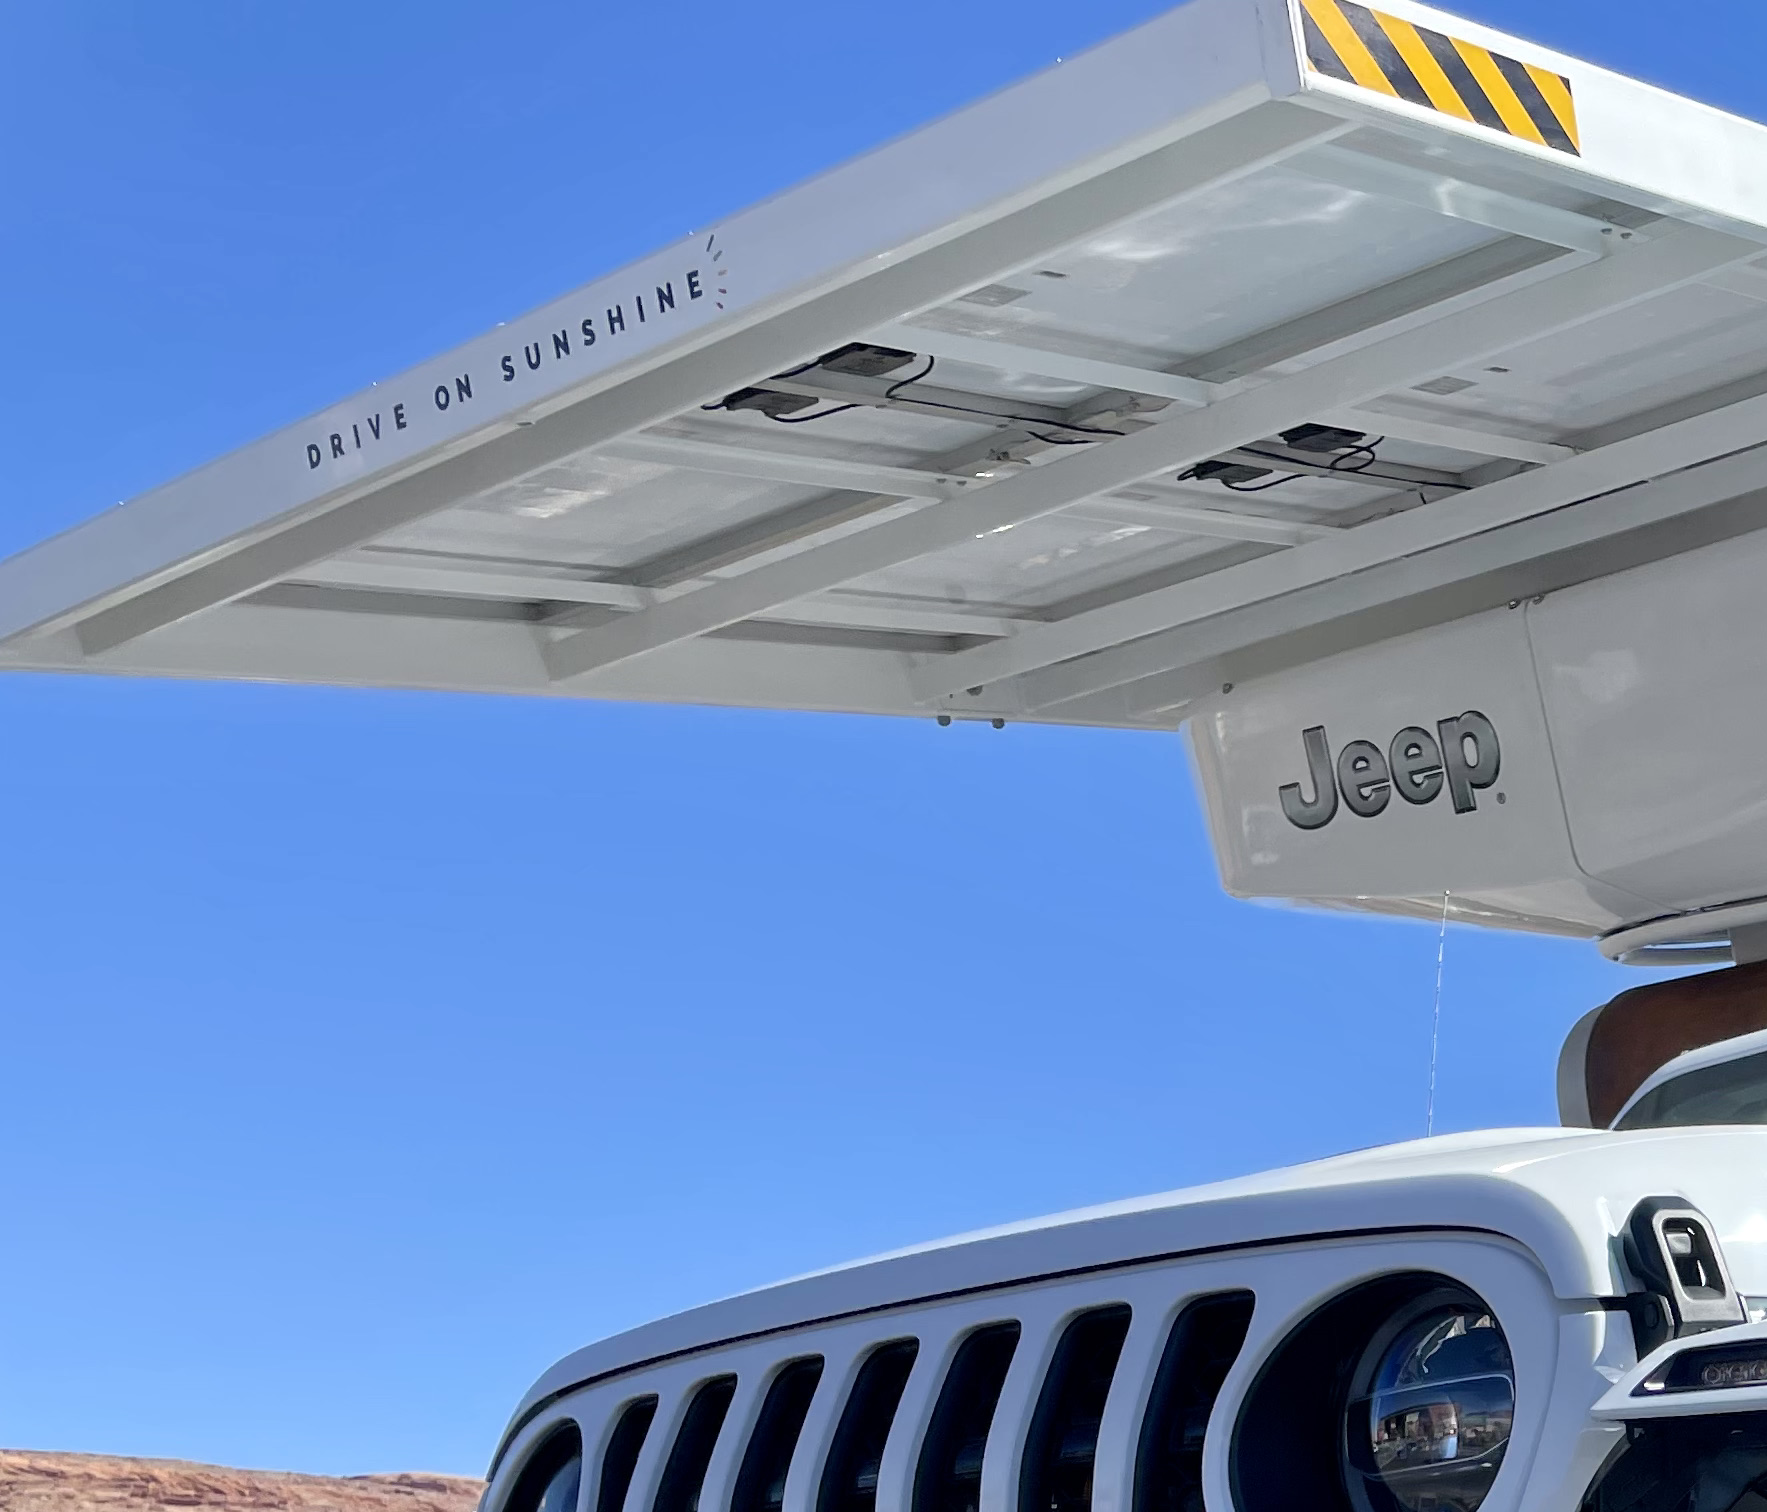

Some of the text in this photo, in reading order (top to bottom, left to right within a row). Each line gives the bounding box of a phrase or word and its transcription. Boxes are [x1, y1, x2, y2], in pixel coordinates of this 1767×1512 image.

[306, 269, 704, 470] DRIVE ON SUNSHINE
[1279, 710, 1502, 830] Jeep
